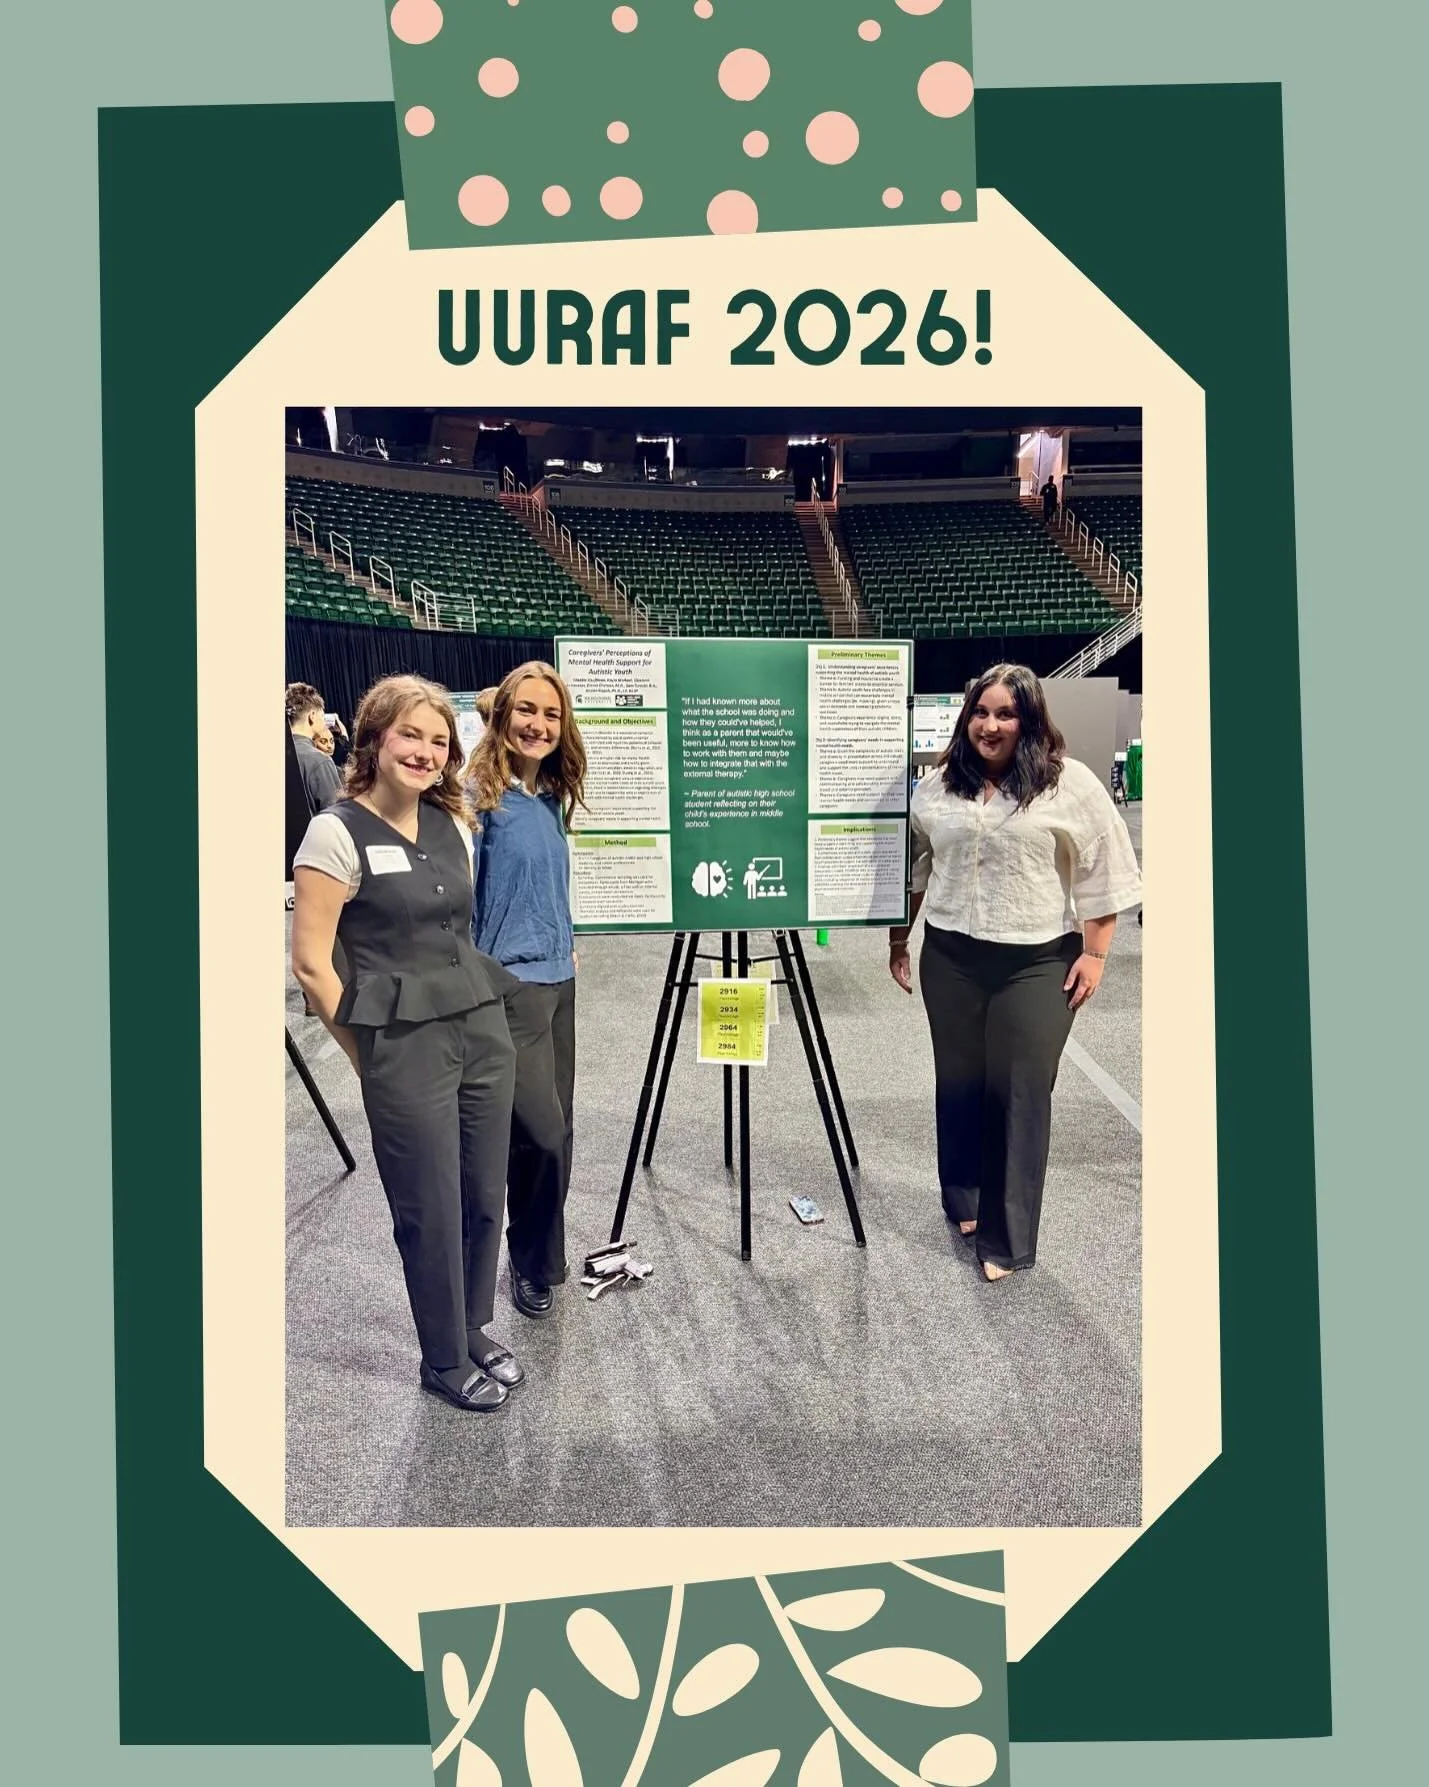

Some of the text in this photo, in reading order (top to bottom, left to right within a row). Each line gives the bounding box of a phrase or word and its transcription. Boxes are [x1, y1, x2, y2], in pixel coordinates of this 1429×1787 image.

[569, 649, 605, 657] Caregivers'
[697, 697, 710, 705] had
[712, 697, 736, 705] known
[760, 697, 780, 705] about
[682, 708, 700, 716] what
[702, 708, 714, 716] the
[715, 708, 740, 716] school
[758, 708, 778, 718] doing
[781, 708, 794, 716] and
[682, 719, 698, 727] how
[700, 719, 715, 728] they
[718, 719, 748, 727] could've
[750, 719, 776, 728] helped,
[683, 729, 700, 737] think
[720, 729, 743, 738] parent
[745, 729, 760, 737] that
[761, 729, 793, 737] would've
[683, 739, 701, 747] been
[704, 739, 727, 749] useful,
[750, 739, 758, 747] to
[760, 739, 778, 747] know
[781, 739, 796, 747] how
[683, 750, 789, 759] to work with them and maybe
[683, 760, 787, 769] how to integrate that with the
[684, 770, 713, 778] external
[691, 790, 716, 798] Parent
[718, 790, 725, 798] of
[727, 790, 752, 798] autistic
[754, 790, 770, 799] high
[772, 790, 795, 798] school
[684, 800, 712, 808] student
[713, 800, 746, 809] reflecting
[760, 800, 776, 808] their
[685, 810, 783, 820] child's experience in middle
